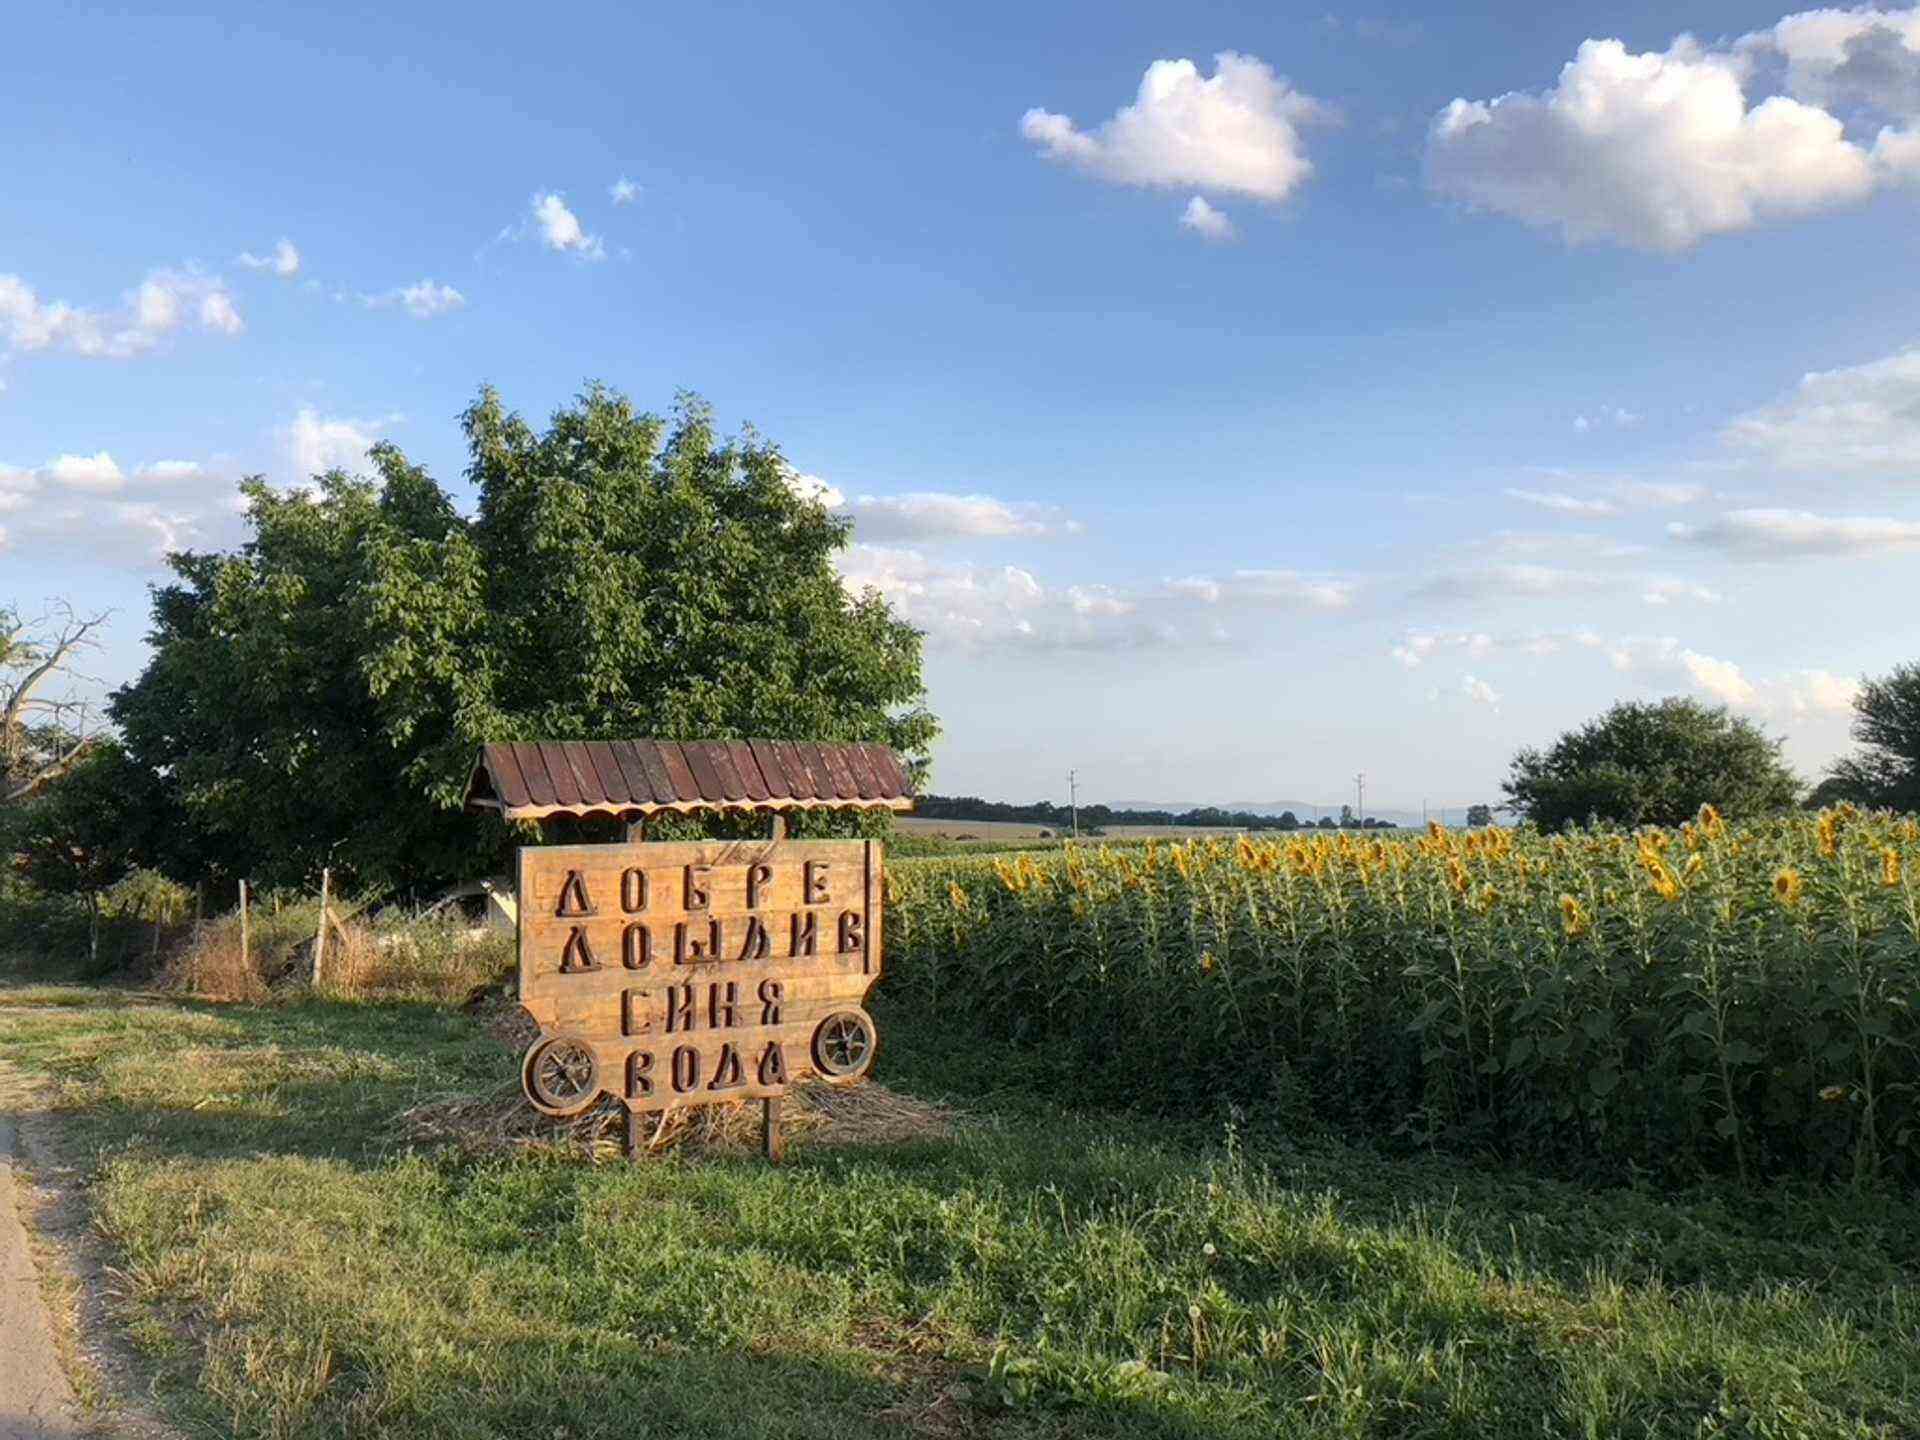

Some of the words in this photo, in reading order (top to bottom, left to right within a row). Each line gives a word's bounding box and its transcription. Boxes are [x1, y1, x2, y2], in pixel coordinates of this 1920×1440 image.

[555, 860, 831, 917] ДОБРЕ
[621, 977, 785, 1036] СИНЯ
[624, 1040, 788, 1099] ВОДА
